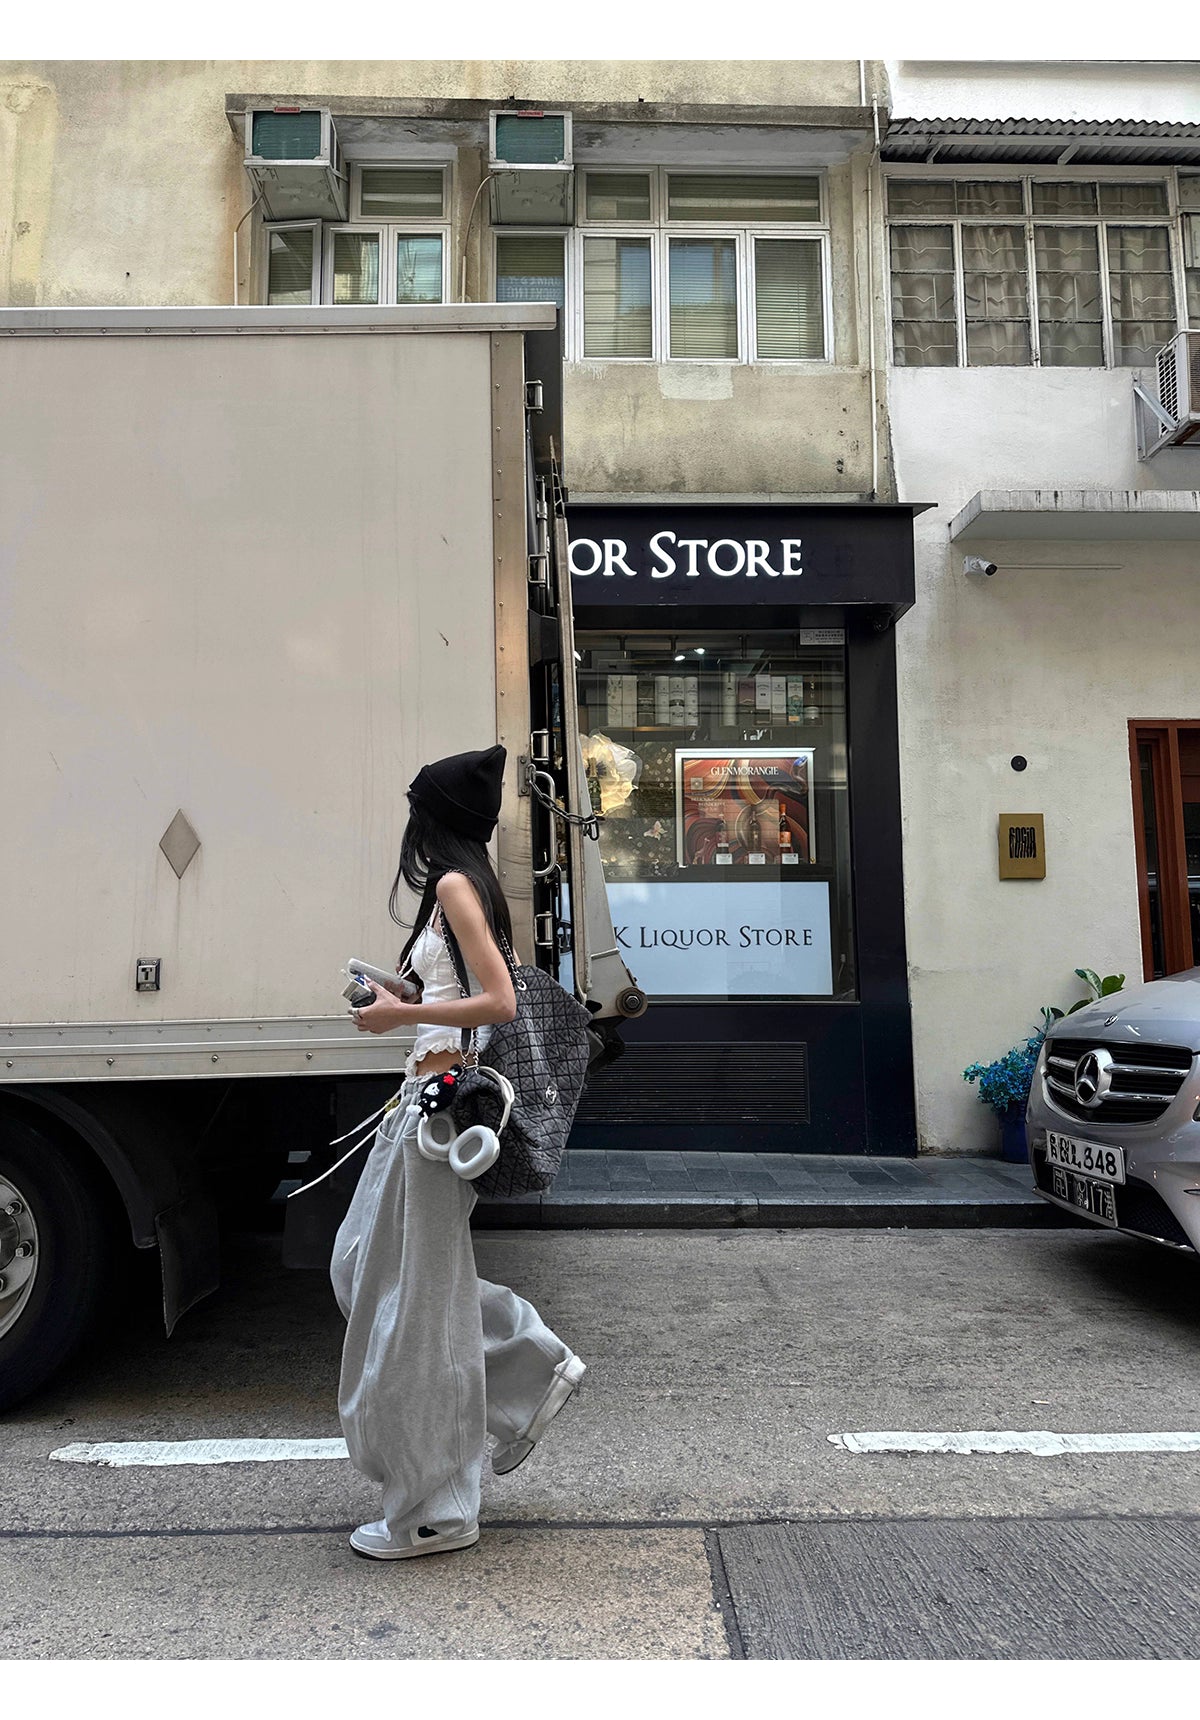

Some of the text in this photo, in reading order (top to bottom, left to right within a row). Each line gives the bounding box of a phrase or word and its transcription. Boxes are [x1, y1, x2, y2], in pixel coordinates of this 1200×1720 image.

[649, 531, 803, 579] STORE
[710, 766, 780, 776] GLENMORANGIE
[639, 926, 731, 950] LIQUOR
[739, 925, 813, 949] STORE
